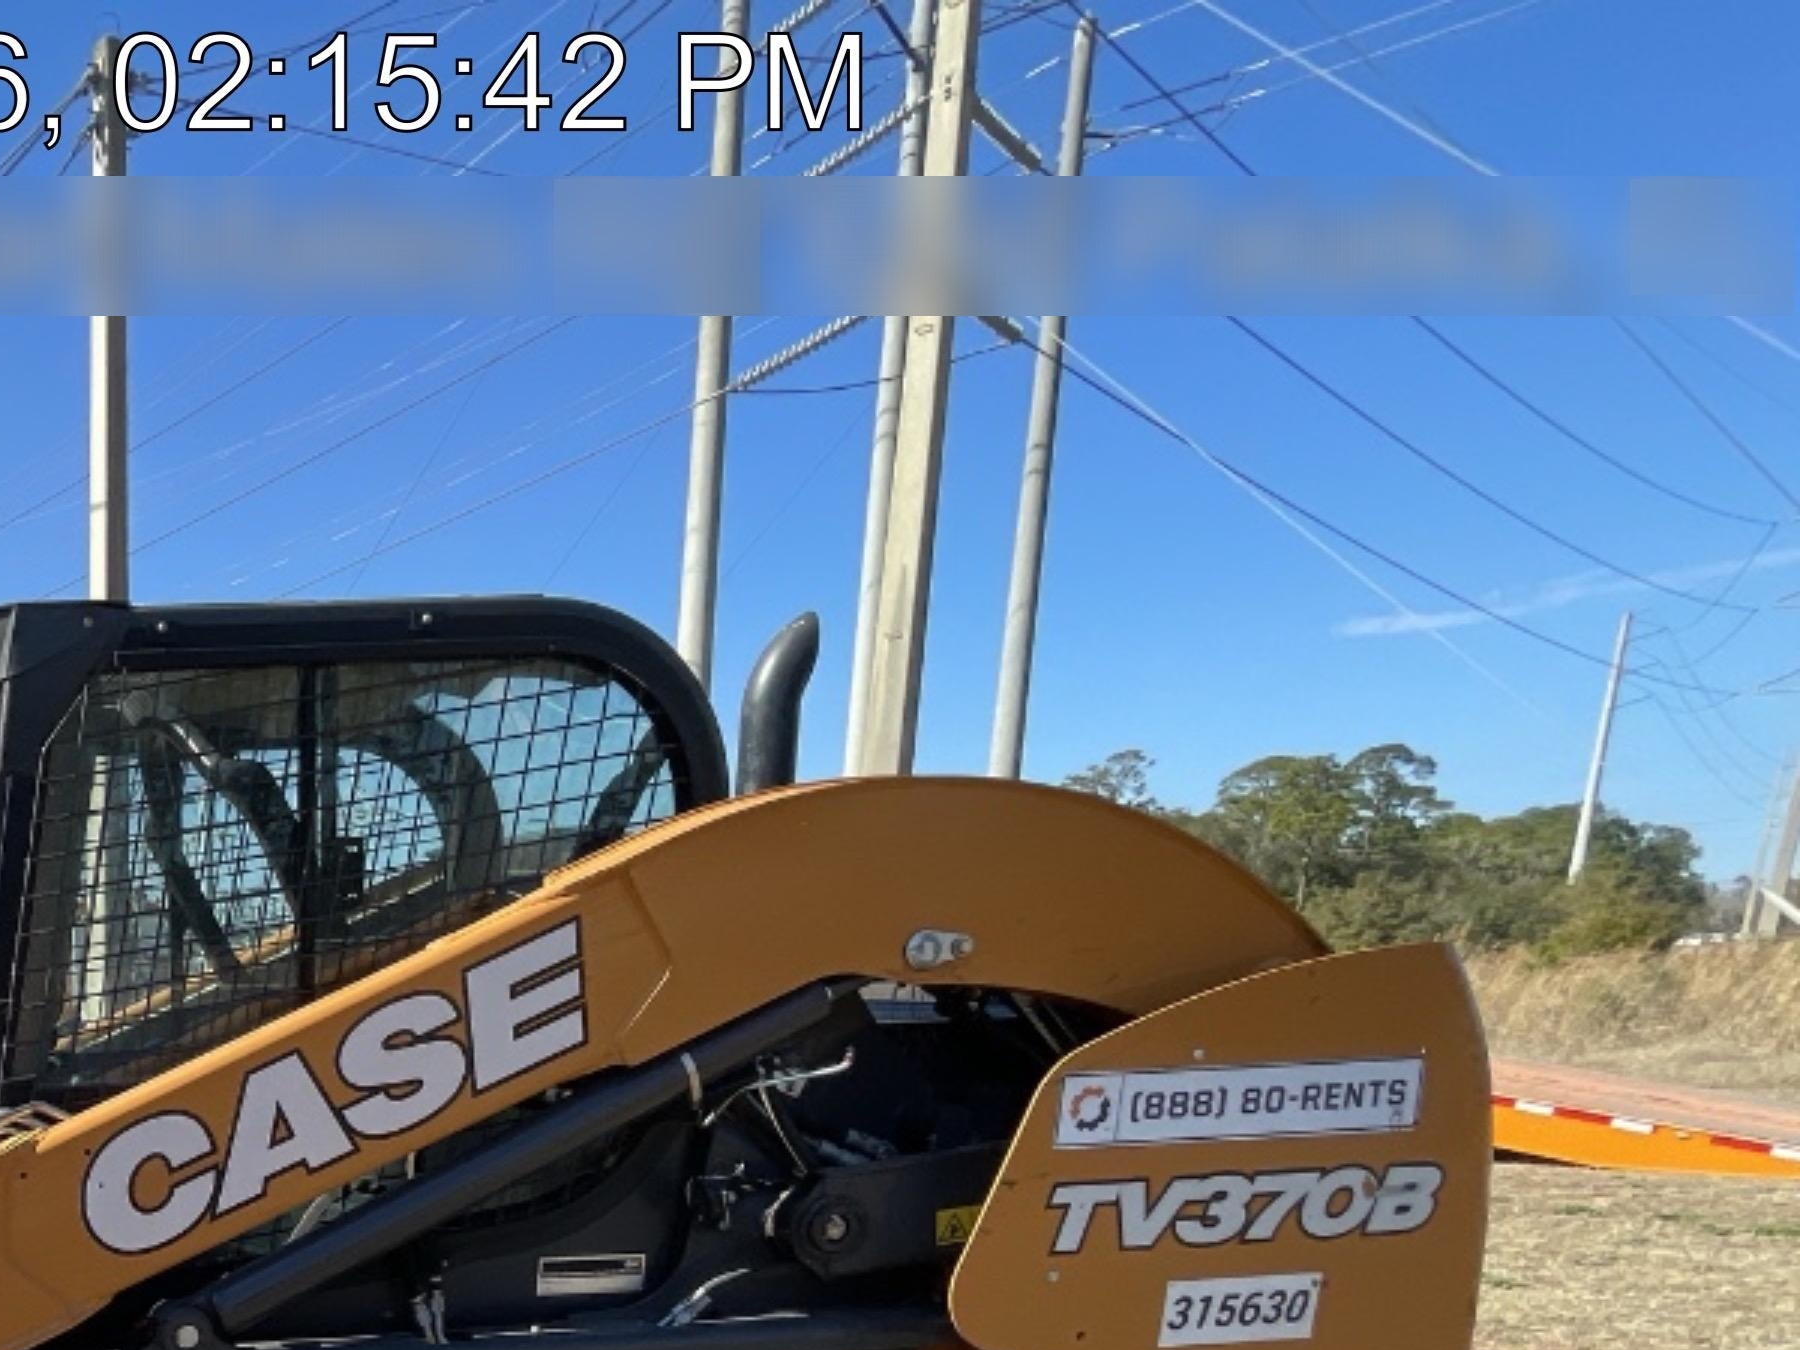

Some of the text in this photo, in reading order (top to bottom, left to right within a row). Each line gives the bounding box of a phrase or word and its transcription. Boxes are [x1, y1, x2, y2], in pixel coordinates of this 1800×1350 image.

[82, 914, 588, 1255] CASE
[1130, 1079, 1408, 1125] (888) 80-RENTS
[1048, 1161, 1446, 1256] TV370B
[1166, 1289, 1310, 1331] 315630
